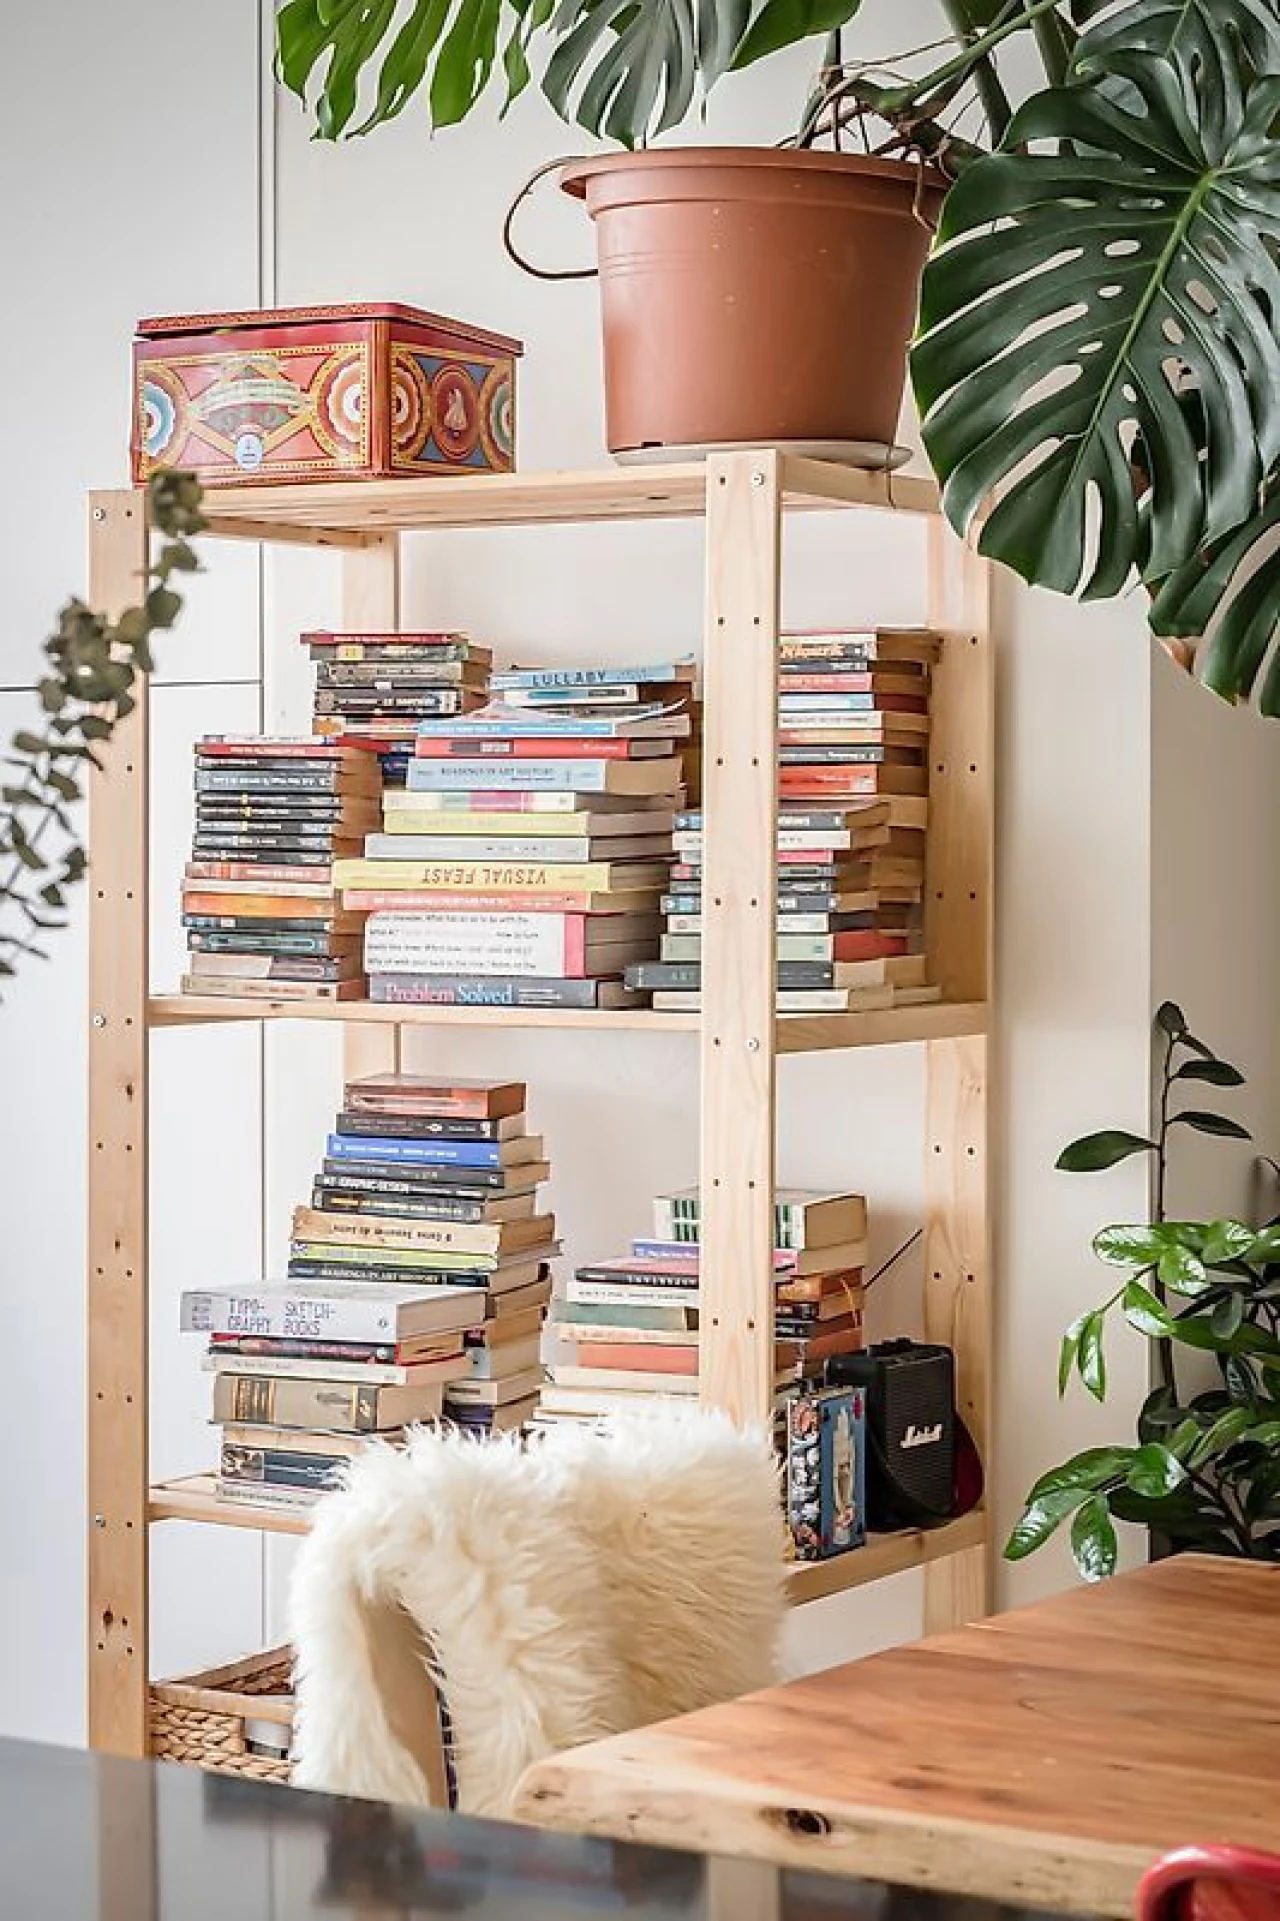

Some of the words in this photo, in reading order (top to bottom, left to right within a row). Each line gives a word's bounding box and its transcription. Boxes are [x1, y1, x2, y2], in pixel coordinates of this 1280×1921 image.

[533, 671, 606, 687] LULLABY
[421, 868, 476, 885] FEAST
[482, 868, 546, 885] VISUAL
[384, 981, 455, 1002] Problem
[458, 983, 514, 1004] Solved
[285, 1300, 336, 1319] SKETCH-
[228, 1315, 270, 1333] GRAPHY
[284, 1317, 321, 1336] BOOKS
